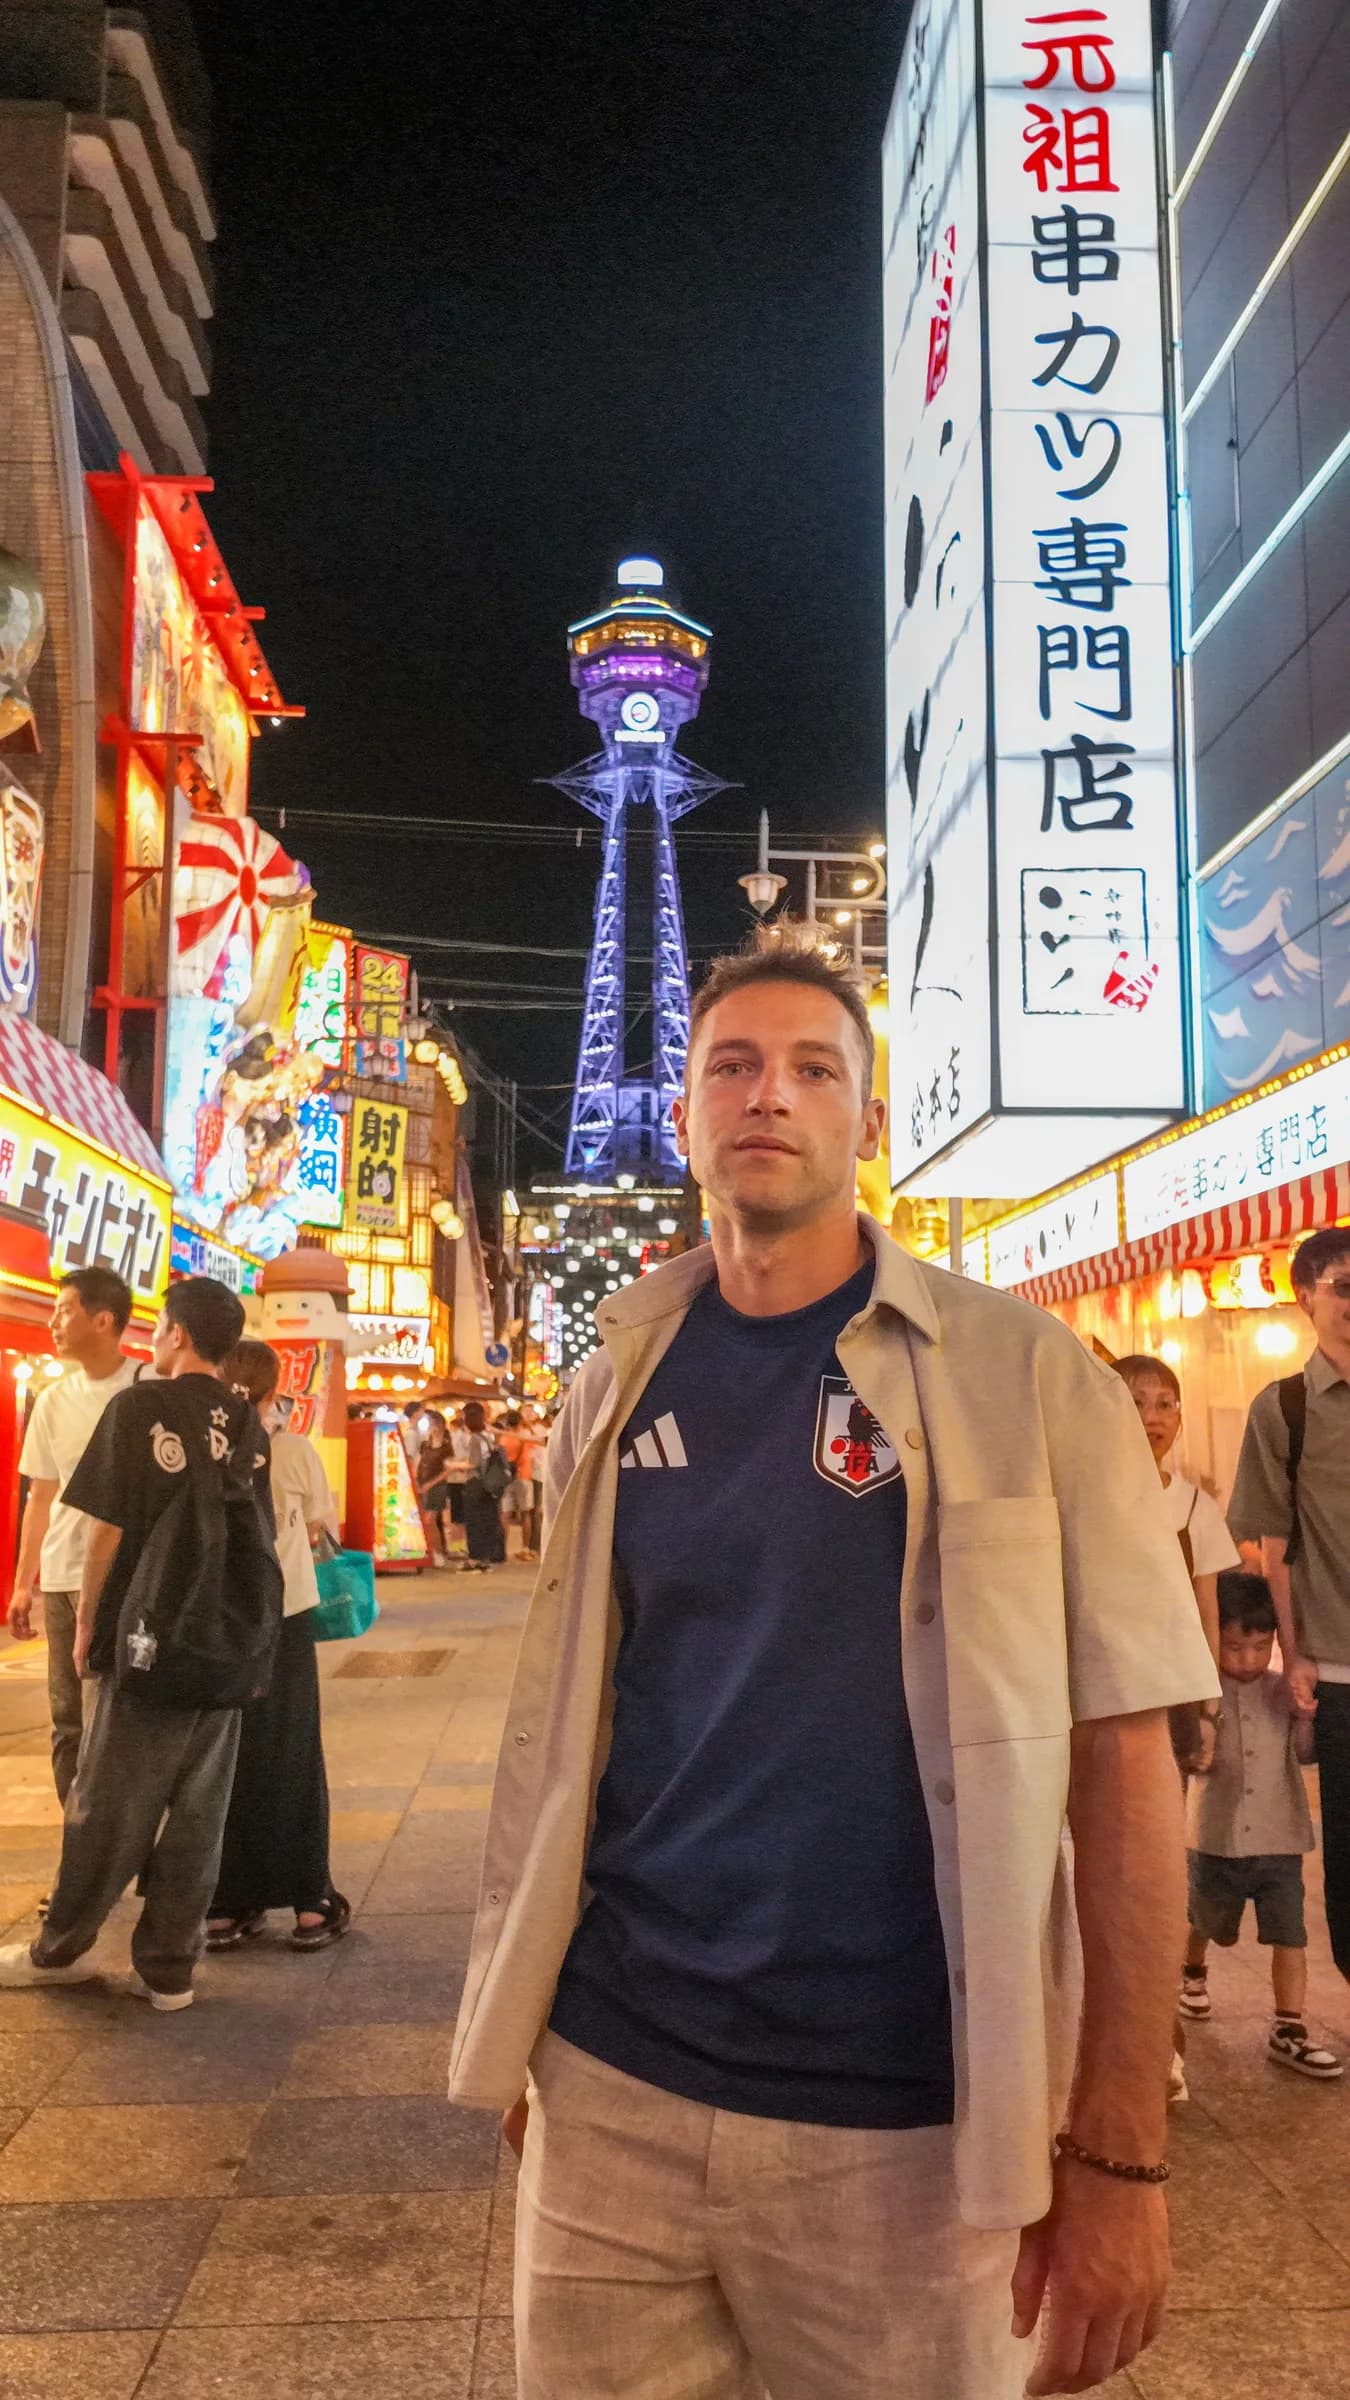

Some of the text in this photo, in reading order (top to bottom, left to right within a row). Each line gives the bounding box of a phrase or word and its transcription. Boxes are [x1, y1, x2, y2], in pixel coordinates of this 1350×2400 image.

[1022, 9, 1135, 832] 元祖串カツ専門店
[357, 1107, 401, 1204] 射的
[837, 1455, 880, 1474] JFA
